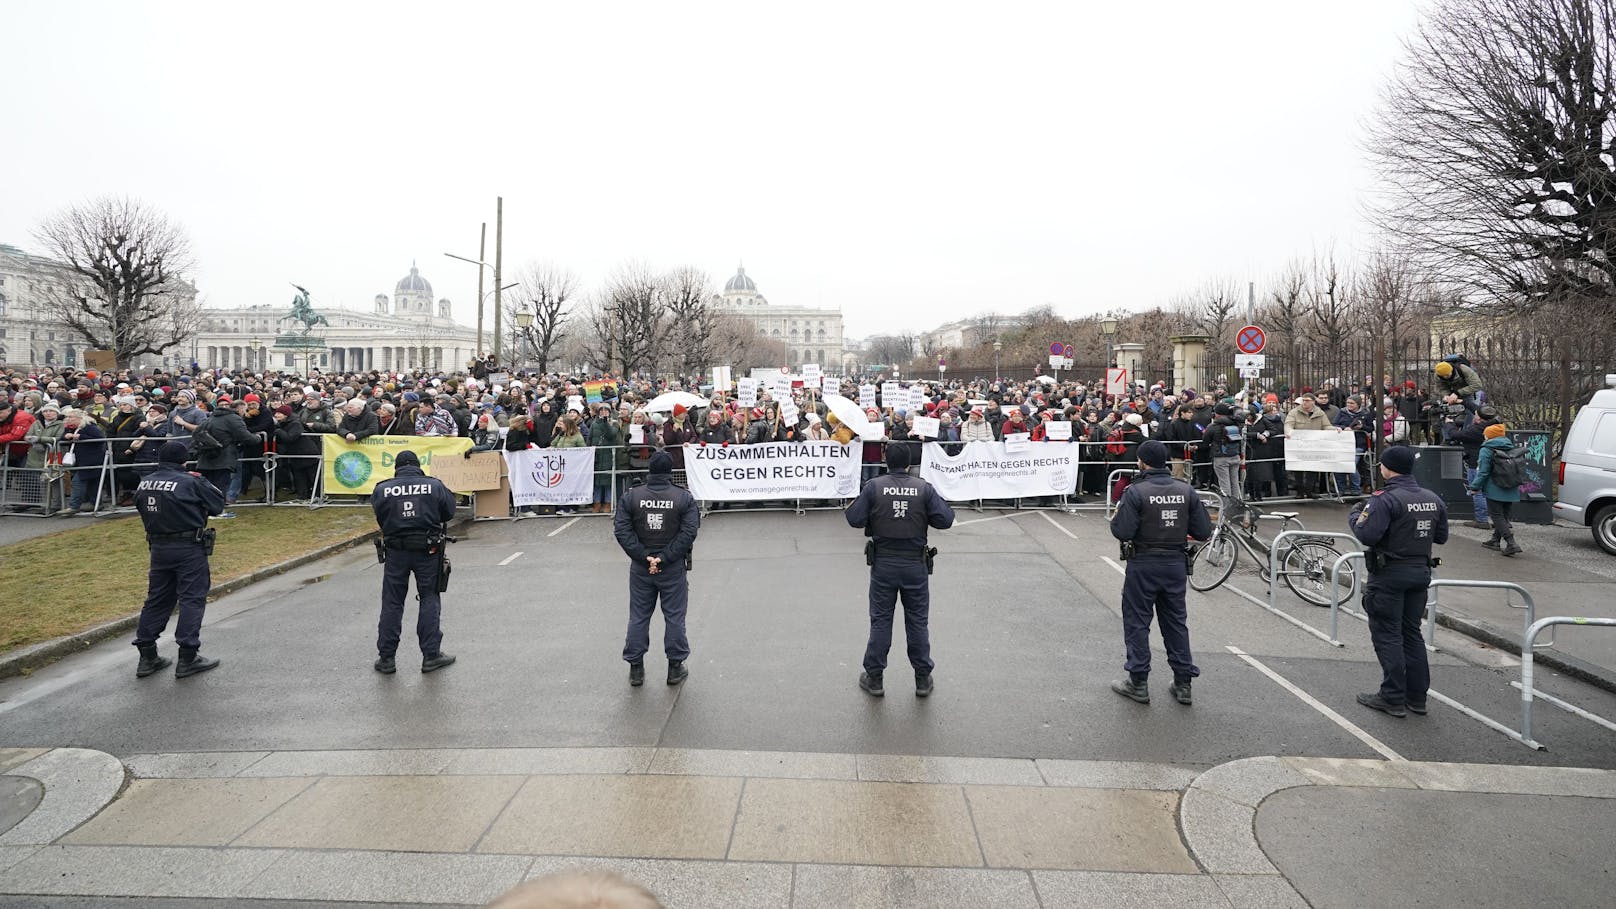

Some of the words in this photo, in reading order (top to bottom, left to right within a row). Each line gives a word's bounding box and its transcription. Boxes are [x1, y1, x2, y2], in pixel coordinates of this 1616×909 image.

[696, 445, 850, 461] ZUSAMMENHALTEN
[1000, 459, 1031, 470] GEGEN
[1034, 457, 1070, 467] RECHTS
[711, 467, 767, 480] GEGEN
[773, 465, 836, 479] RECHTS
[136, 480, 178, 492] POLIZEI
[384, 484, 432, 498] POLIZEI
[729, 485, 818, 495] www.omasgegenrechts.at
[883, 487, 918, 496] POLIZEI
[148, 496, 157, 506] D
[640, 499, 673, 509] POLIZEI
[1149, 495, 1185, 504] POLIZEI
[403, 501, 414, 511] D
[892, 500, 908, 510] BE
[1407, 502, 1438, 512] POLIZEI
[402, 510, 416, 518] 151
[647, 513, 663, 524] BE
[894, 509, 906, 518] 24
[1161, 509, 1178, 520] BE
[1416, 519, 1431, 530] BE
